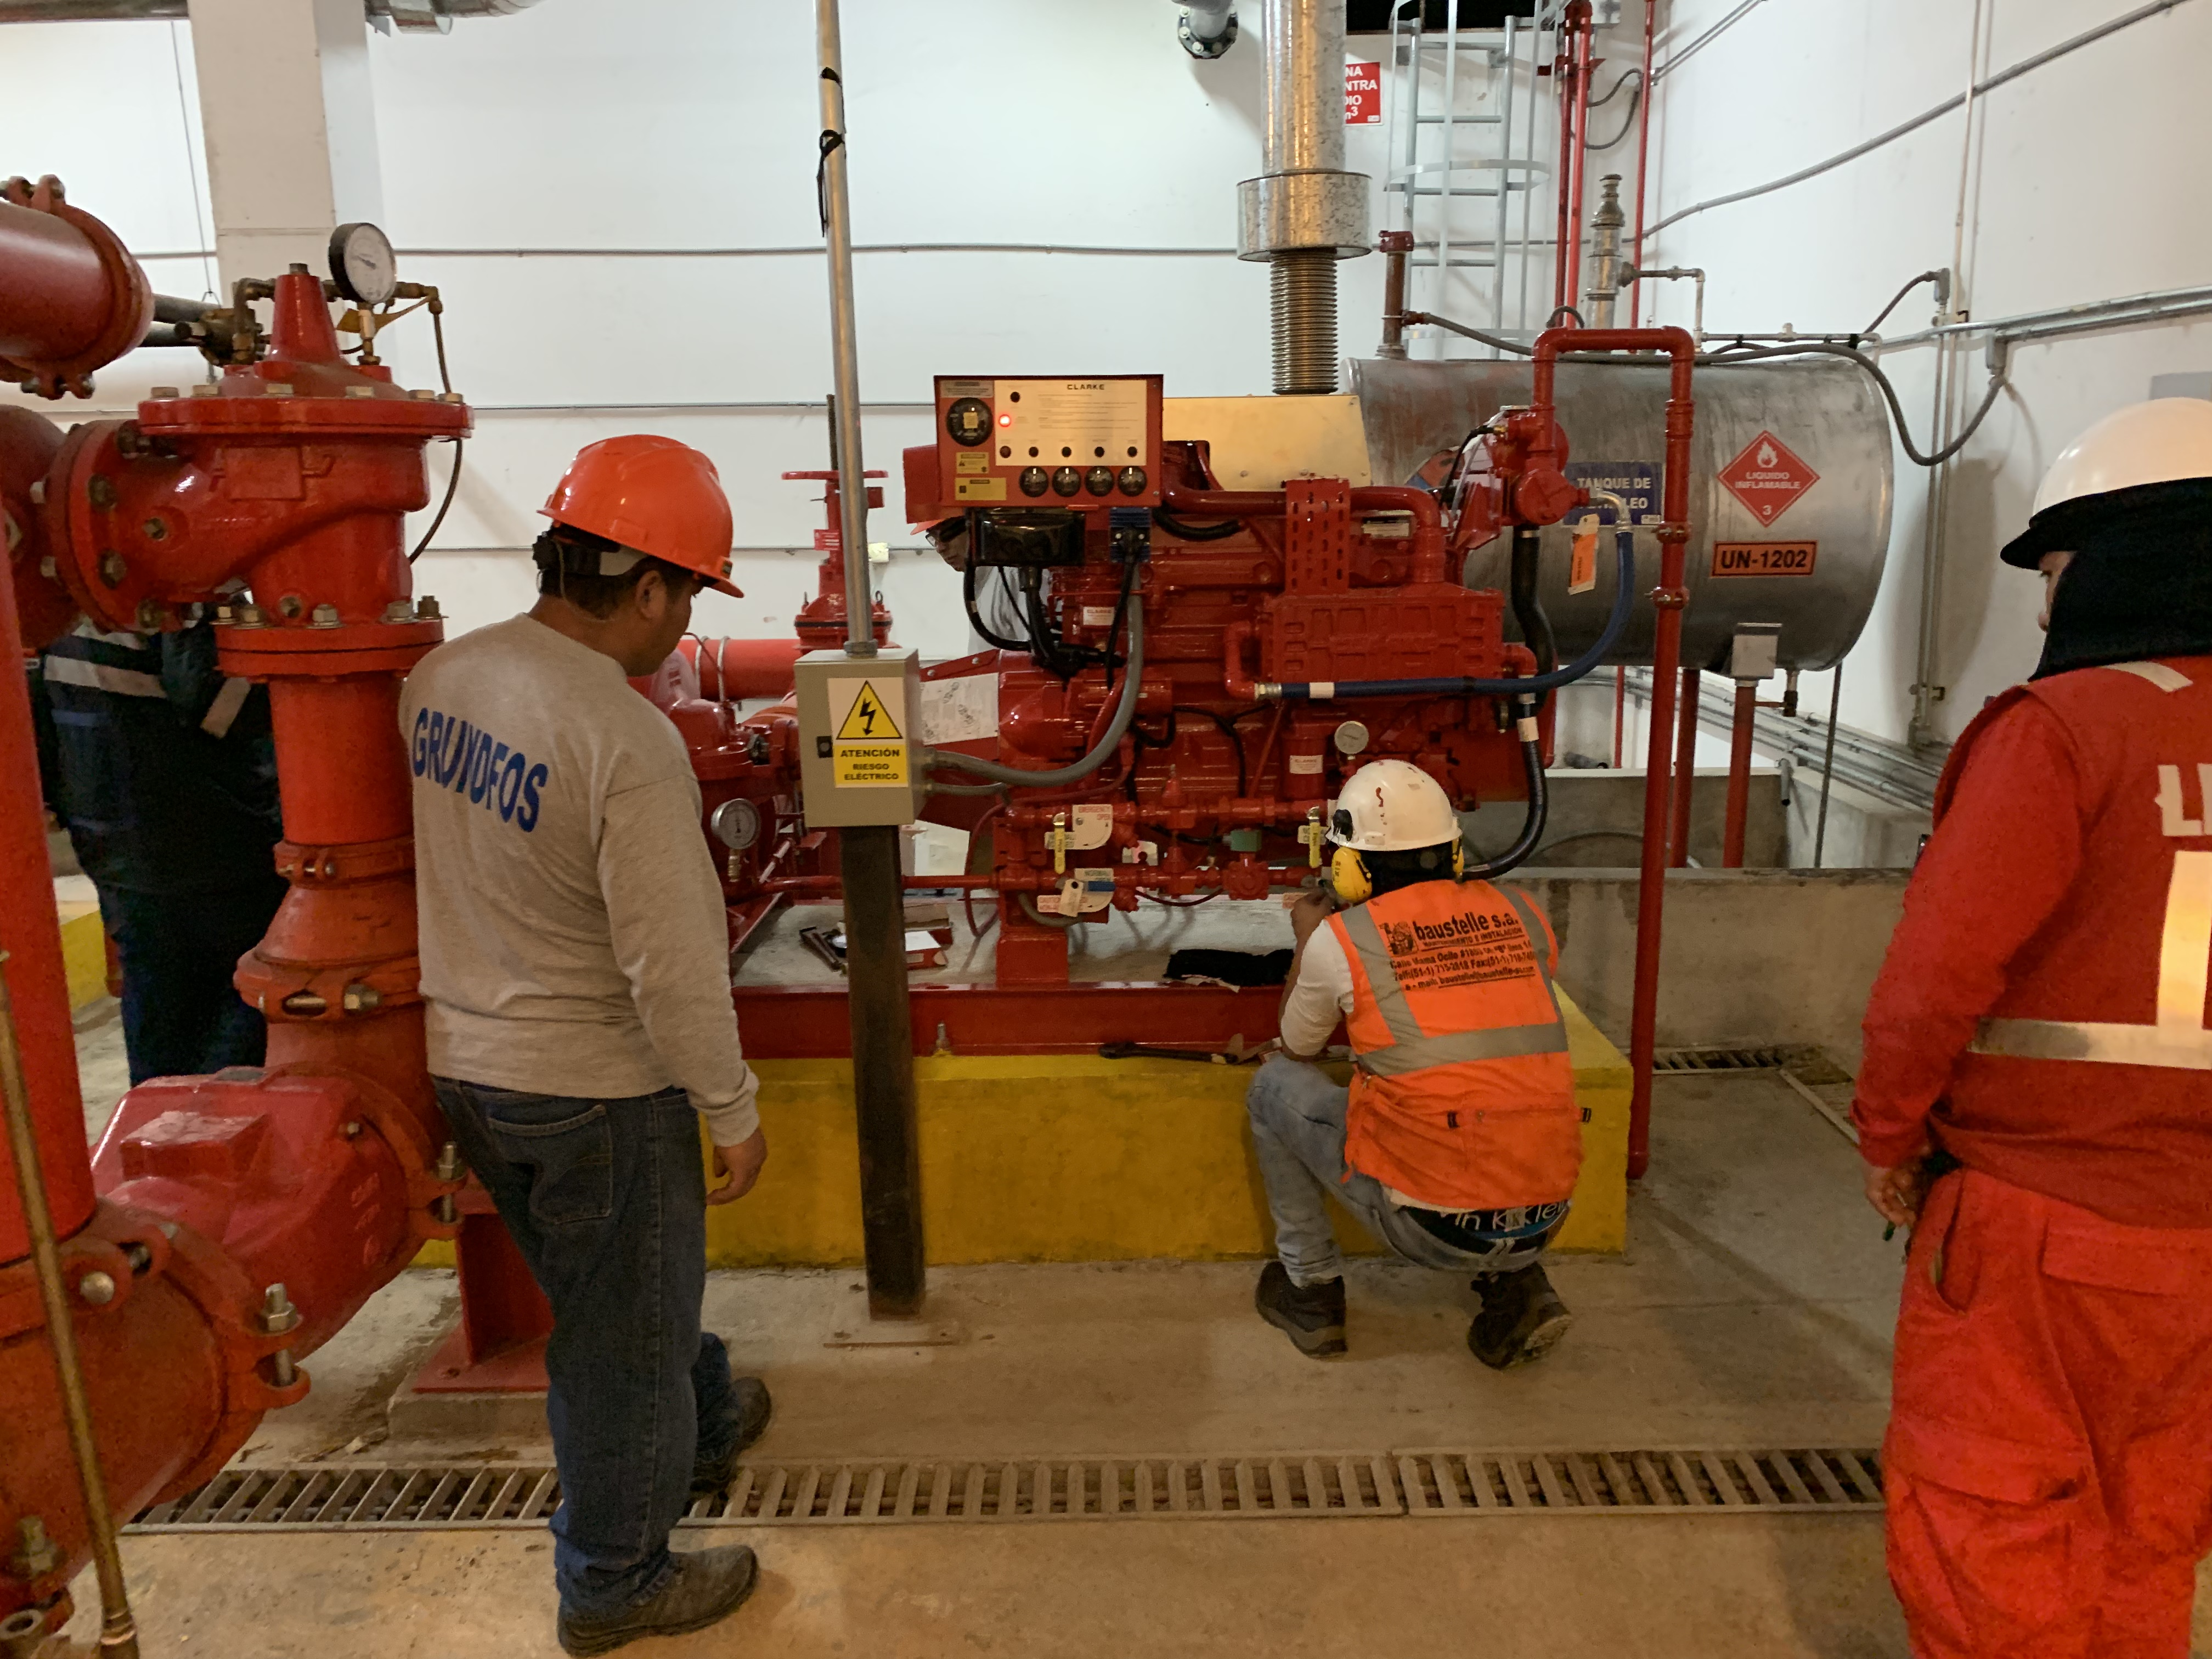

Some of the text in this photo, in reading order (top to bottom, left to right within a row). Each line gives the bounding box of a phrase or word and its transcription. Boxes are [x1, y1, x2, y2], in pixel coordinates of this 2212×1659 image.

[1633, 478, 1651, 489] DE
[1763, 505, 1771, 516] 3
[1720, 550, 1807, 568] UN-1202
[840, 747, 900, 757] ATENCIÓN
[413, 707, 548, 833] GRUNDFOS
[1412, 911, 1519, 941] baustelle s.a.
